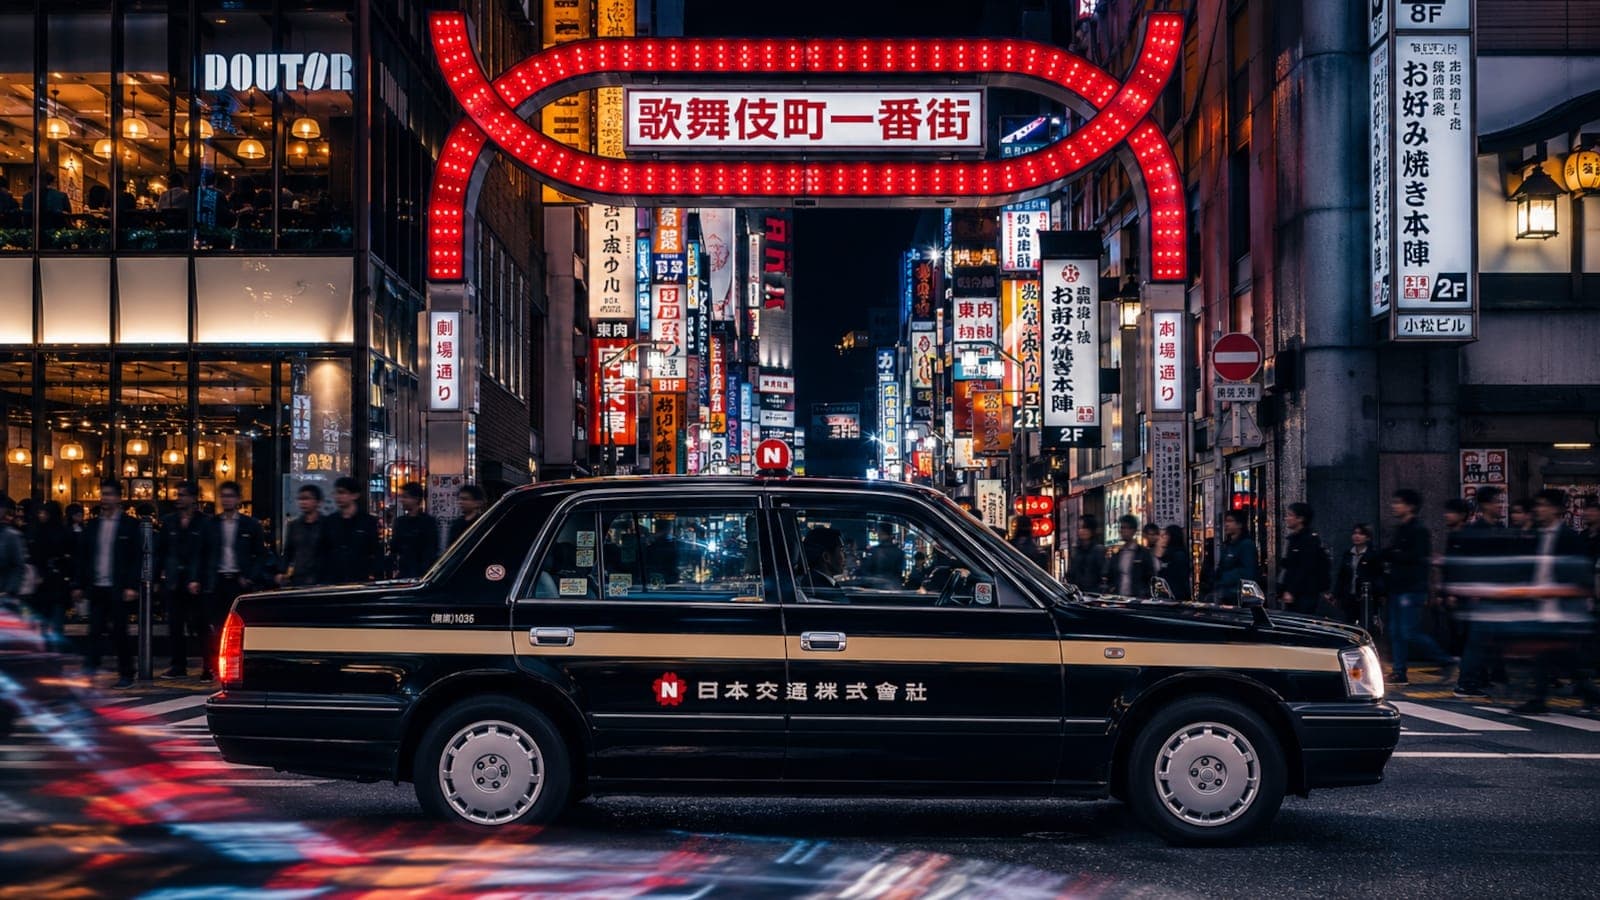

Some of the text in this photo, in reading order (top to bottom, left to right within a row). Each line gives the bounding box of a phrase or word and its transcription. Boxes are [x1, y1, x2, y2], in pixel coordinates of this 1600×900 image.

[1410, 4, 1442, 23] 8F
[205, 52, 353, 91] DOUTOR
[638, 97, 971, 141] 歌舞伎町一番街
[1403, 60, 1430, 268] お好み焼き本陣
[1437, 278, 1465, 298] 2F
[1404, 318, 1466, 333] 小松ビル
[659, 380, 680, 392] B1F
[1060, 431, 1083, 446] 2F
[764, 448, 781, 464] N
[661, 682, 677, 698] N
